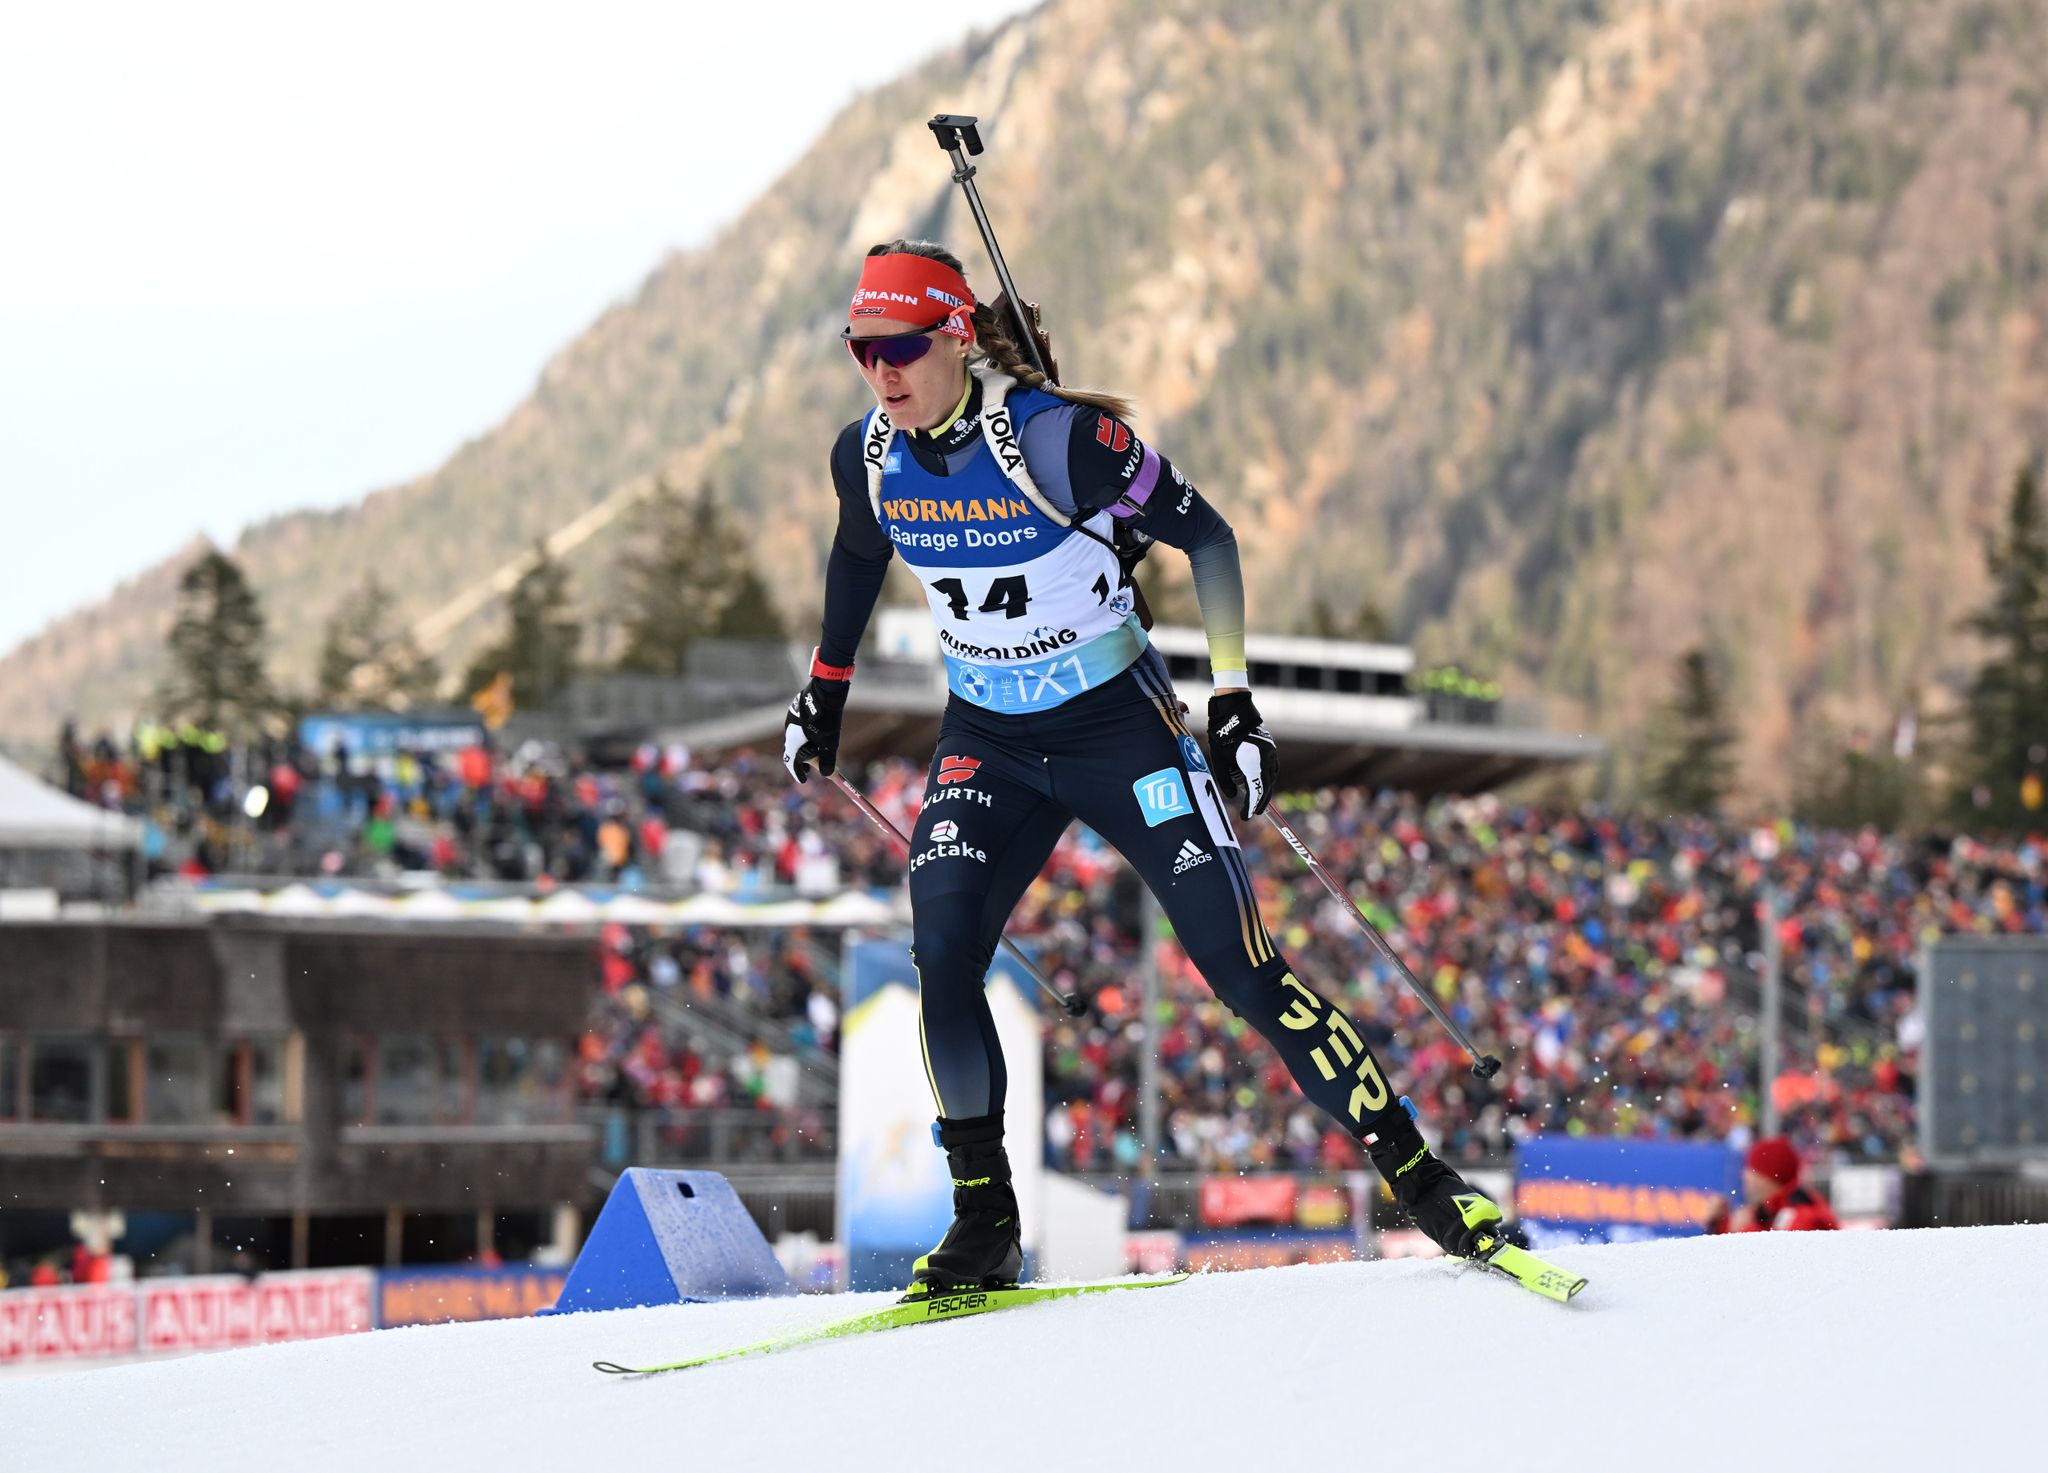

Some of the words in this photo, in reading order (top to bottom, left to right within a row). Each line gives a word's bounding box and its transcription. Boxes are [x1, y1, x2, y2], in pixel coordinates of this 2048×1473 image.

[865, 412, 891, 470] JOKA
[949, 414, 981, 445] tectake
[985, 410, 1022, 473] JOKA
[1121, 439, 1141, 479] WÜR
[882, 497, 1031, 523] HÖRMANN
[889, 524, 959, 552] Garage
[964, 526, 1038, 548] Doors
[930, 574, 1032, 621] 14
[1090, 571, 1110, 607] 1
[1001, 676, 1014, 706] THE
[1012, 654, 1089, 703] iX1
[919, 787, 993, 815] WÜRTH
[1141, 777, 1184, 812] TQ
[910, 842, 987, 872] tectake
[1173, 852, 1213, 875] adidas
[1278, 971, 1388, 1124] GER
[952, 1176, 990, 1187] SCHER
[927, 1294, 988, 1316] FISCHER
